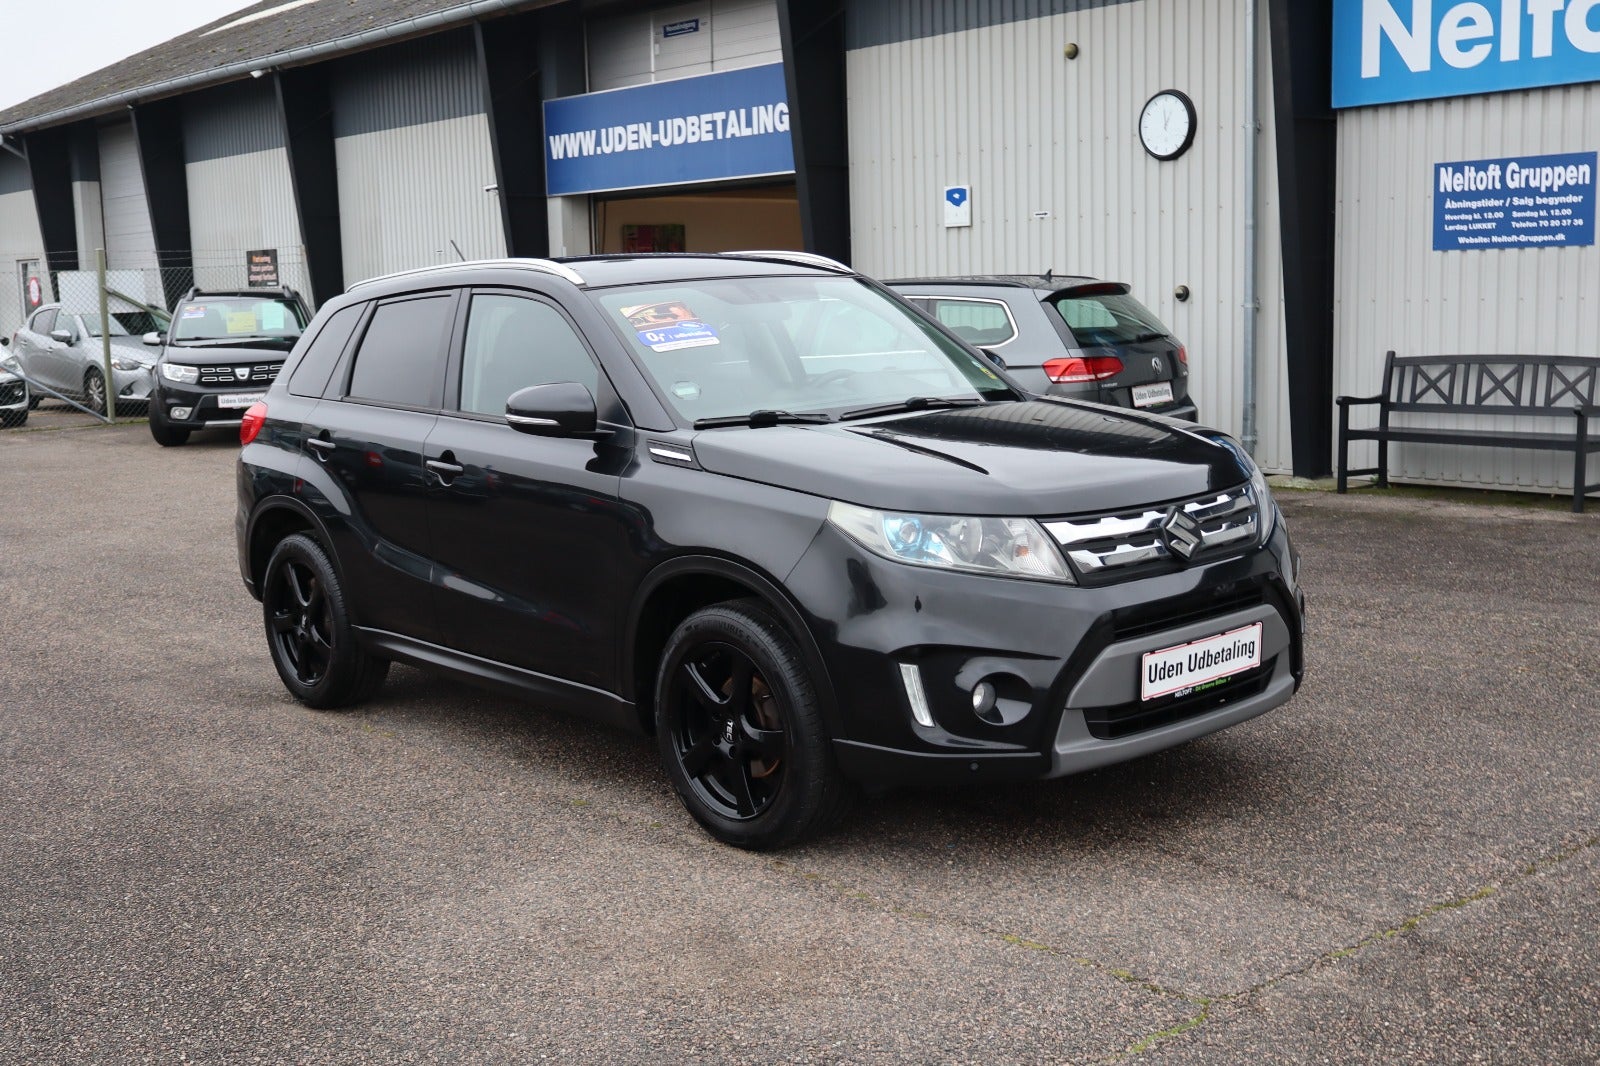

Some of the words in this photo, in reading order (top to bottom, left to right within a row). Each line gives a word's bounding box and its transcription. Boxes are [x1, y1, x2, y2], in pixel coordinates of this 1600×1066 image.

[549, 102, 790, 160] WWW.UDEN-UDBETALING
[1440, 164, 1501, 192] Neltoft
[1506, 162, 1590, 192] Gruppen
[1445, 198, 1504, 209] Åbningstider
[1505, 198, 1510, 207] /
[1512, 196, 1534, 206] Salg
[1536, 194, 1584, 205] begynder
[1148, 661, 1183, 683] Uden
[1188, 640, 1255, 672] Udbetaling
